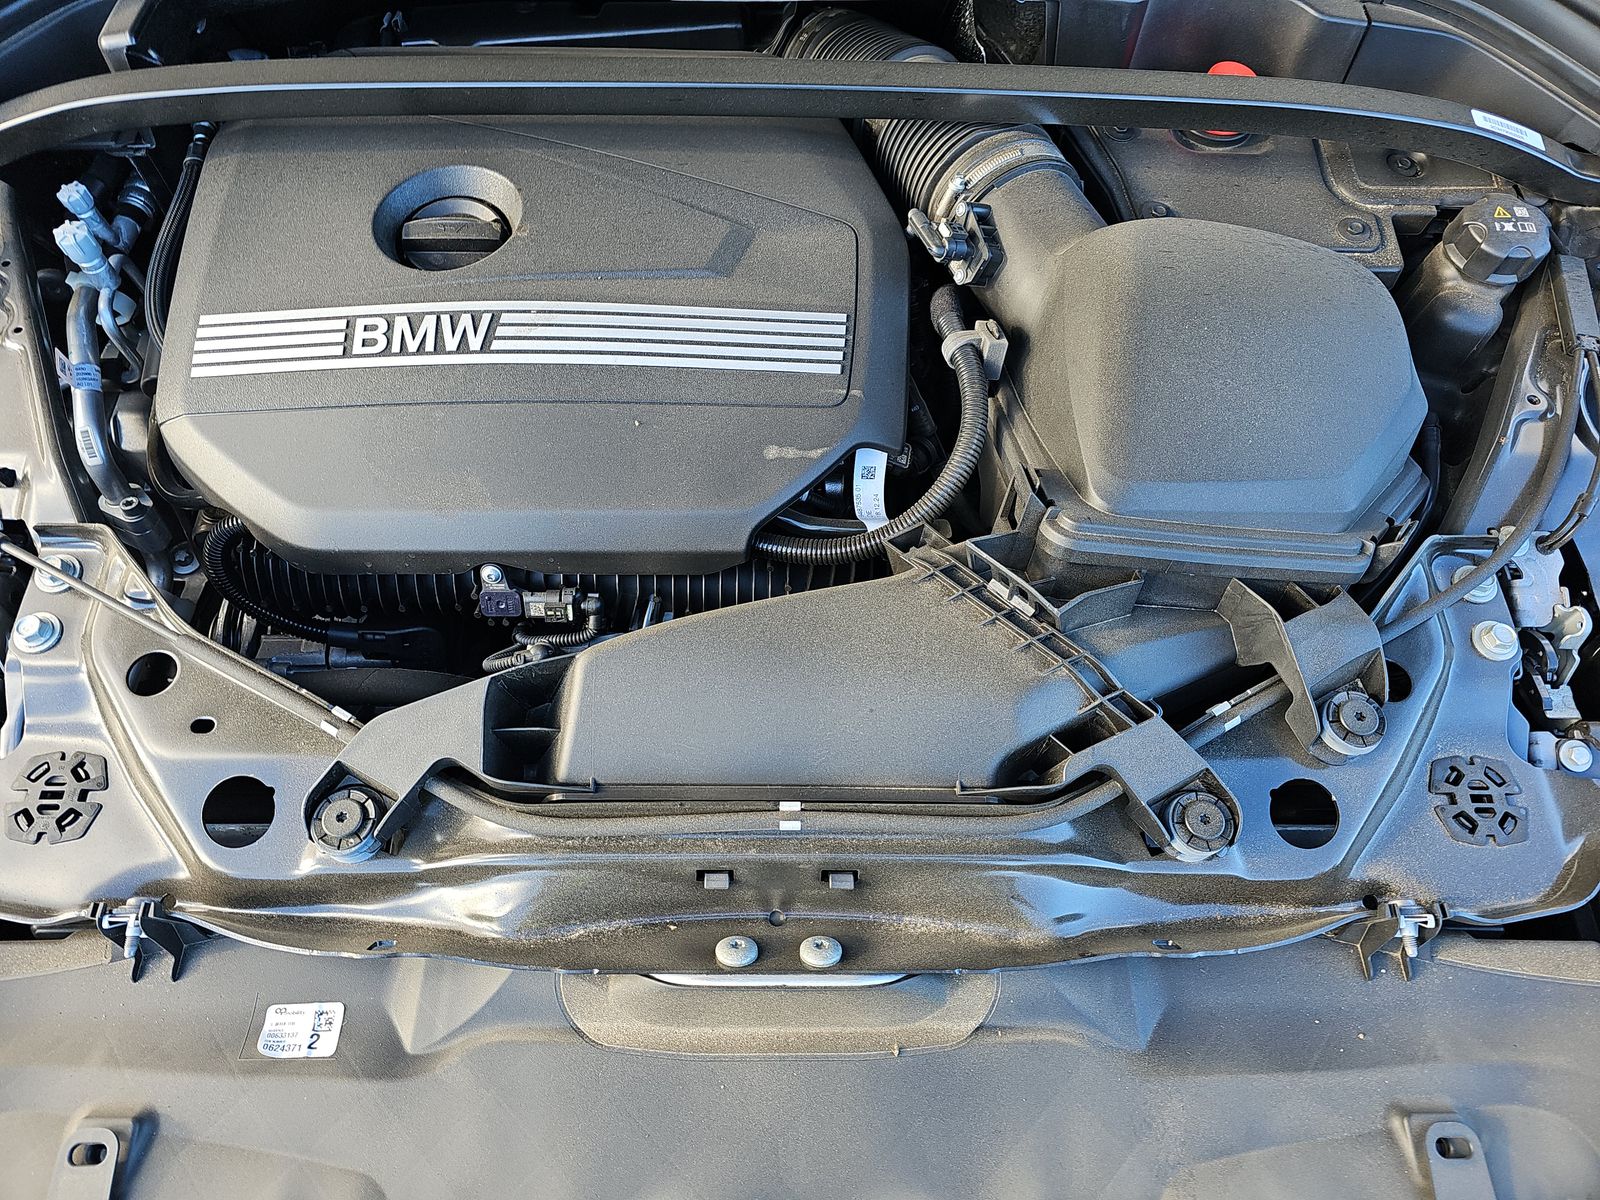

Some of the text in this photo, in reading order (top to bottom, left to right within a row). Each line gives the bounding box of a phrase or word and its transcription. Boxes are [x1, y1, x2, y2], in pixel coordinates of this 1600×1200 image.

[352, 312, 493, 355] BMW
[262, 1043, 301, 1052] 0624371
[307, 1033, 320, 1049] 2
